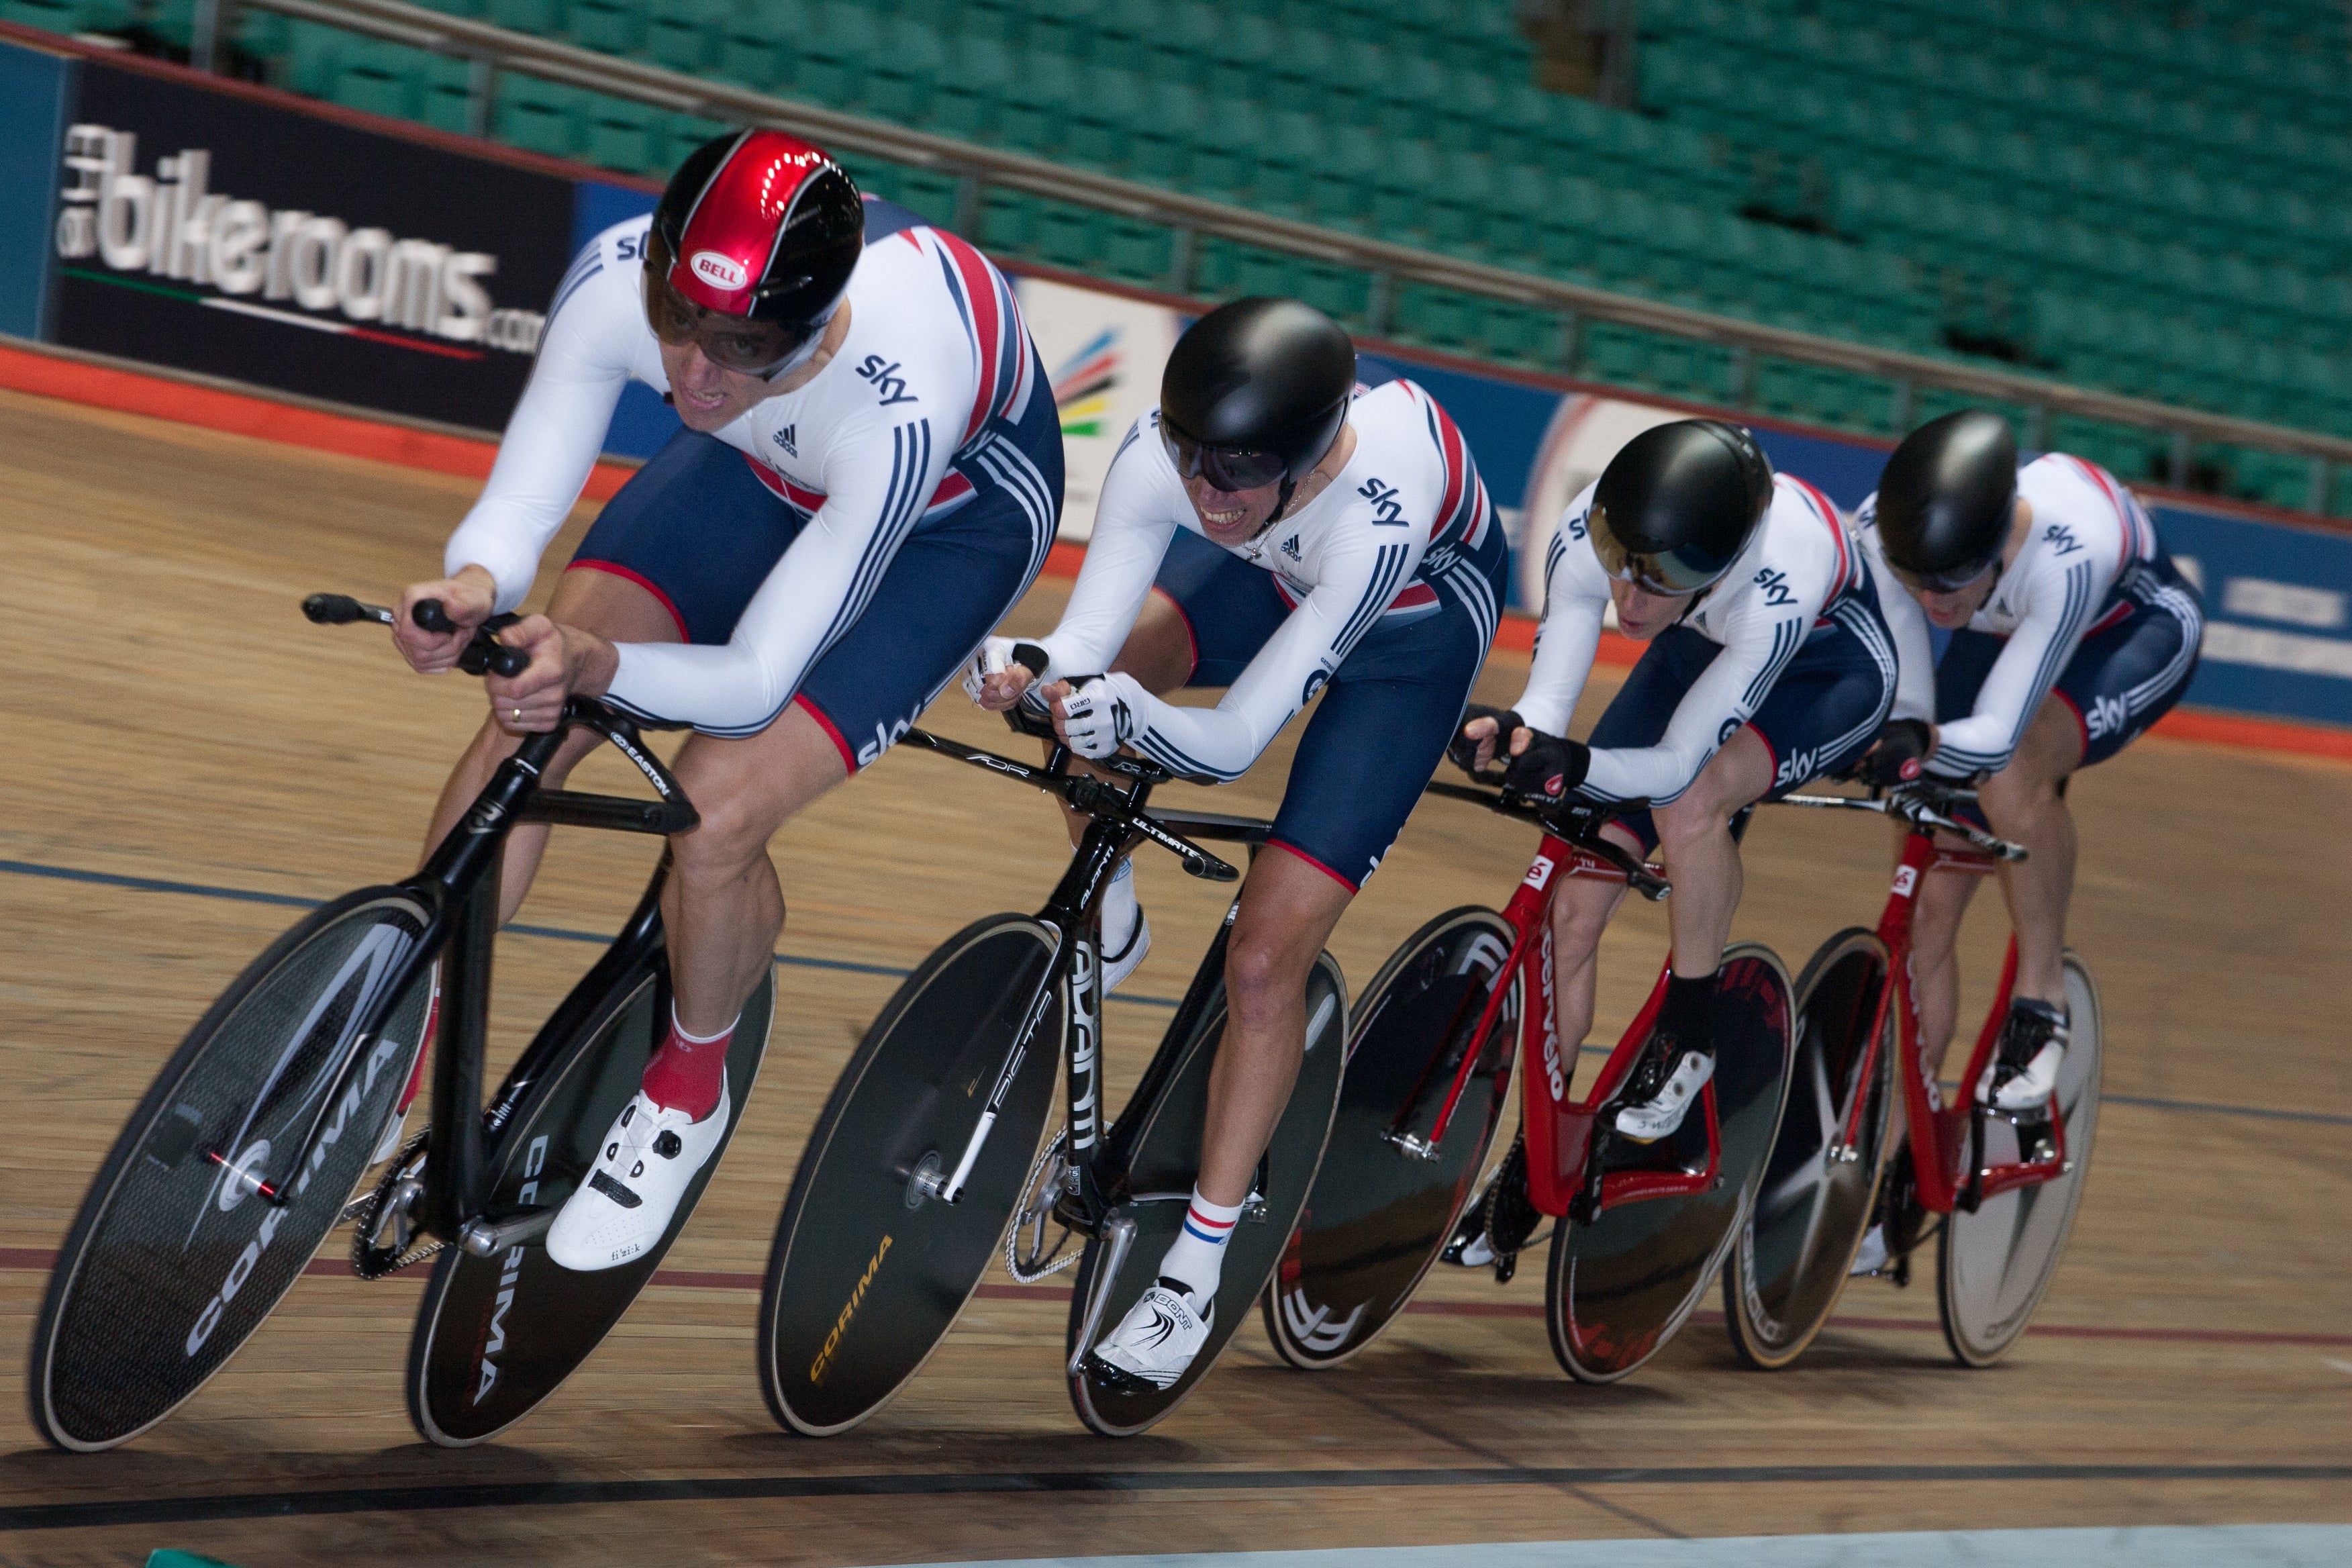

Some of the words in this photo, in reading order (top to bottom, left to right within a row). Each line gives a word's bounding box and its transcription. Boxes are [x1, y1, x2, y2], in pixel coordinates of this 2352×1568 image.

[699, 258, 736, 284] BELL
[854, 354, 919, 407] sky
[773, 433, 798, 458] adidas
[1357, 477, 1410, 528] sky
[1280, 545, 1303, 563] adidas
[1421, 542, 1462, 576] sky
[1753, 567, 1799, 606] sky
[1069, 697, 1091, 710] GIRO
[627, 746, 671, 796] EASTON
[1774, 746, 1818, 788] sky
[1132, 817, 1201, 858] ULTIMATE
[186, 1038, 399, 1357] CORIMA
[810, 1234, 893, 1384] CORIMA
[1153, 1293, 1193, 1330] BONT
